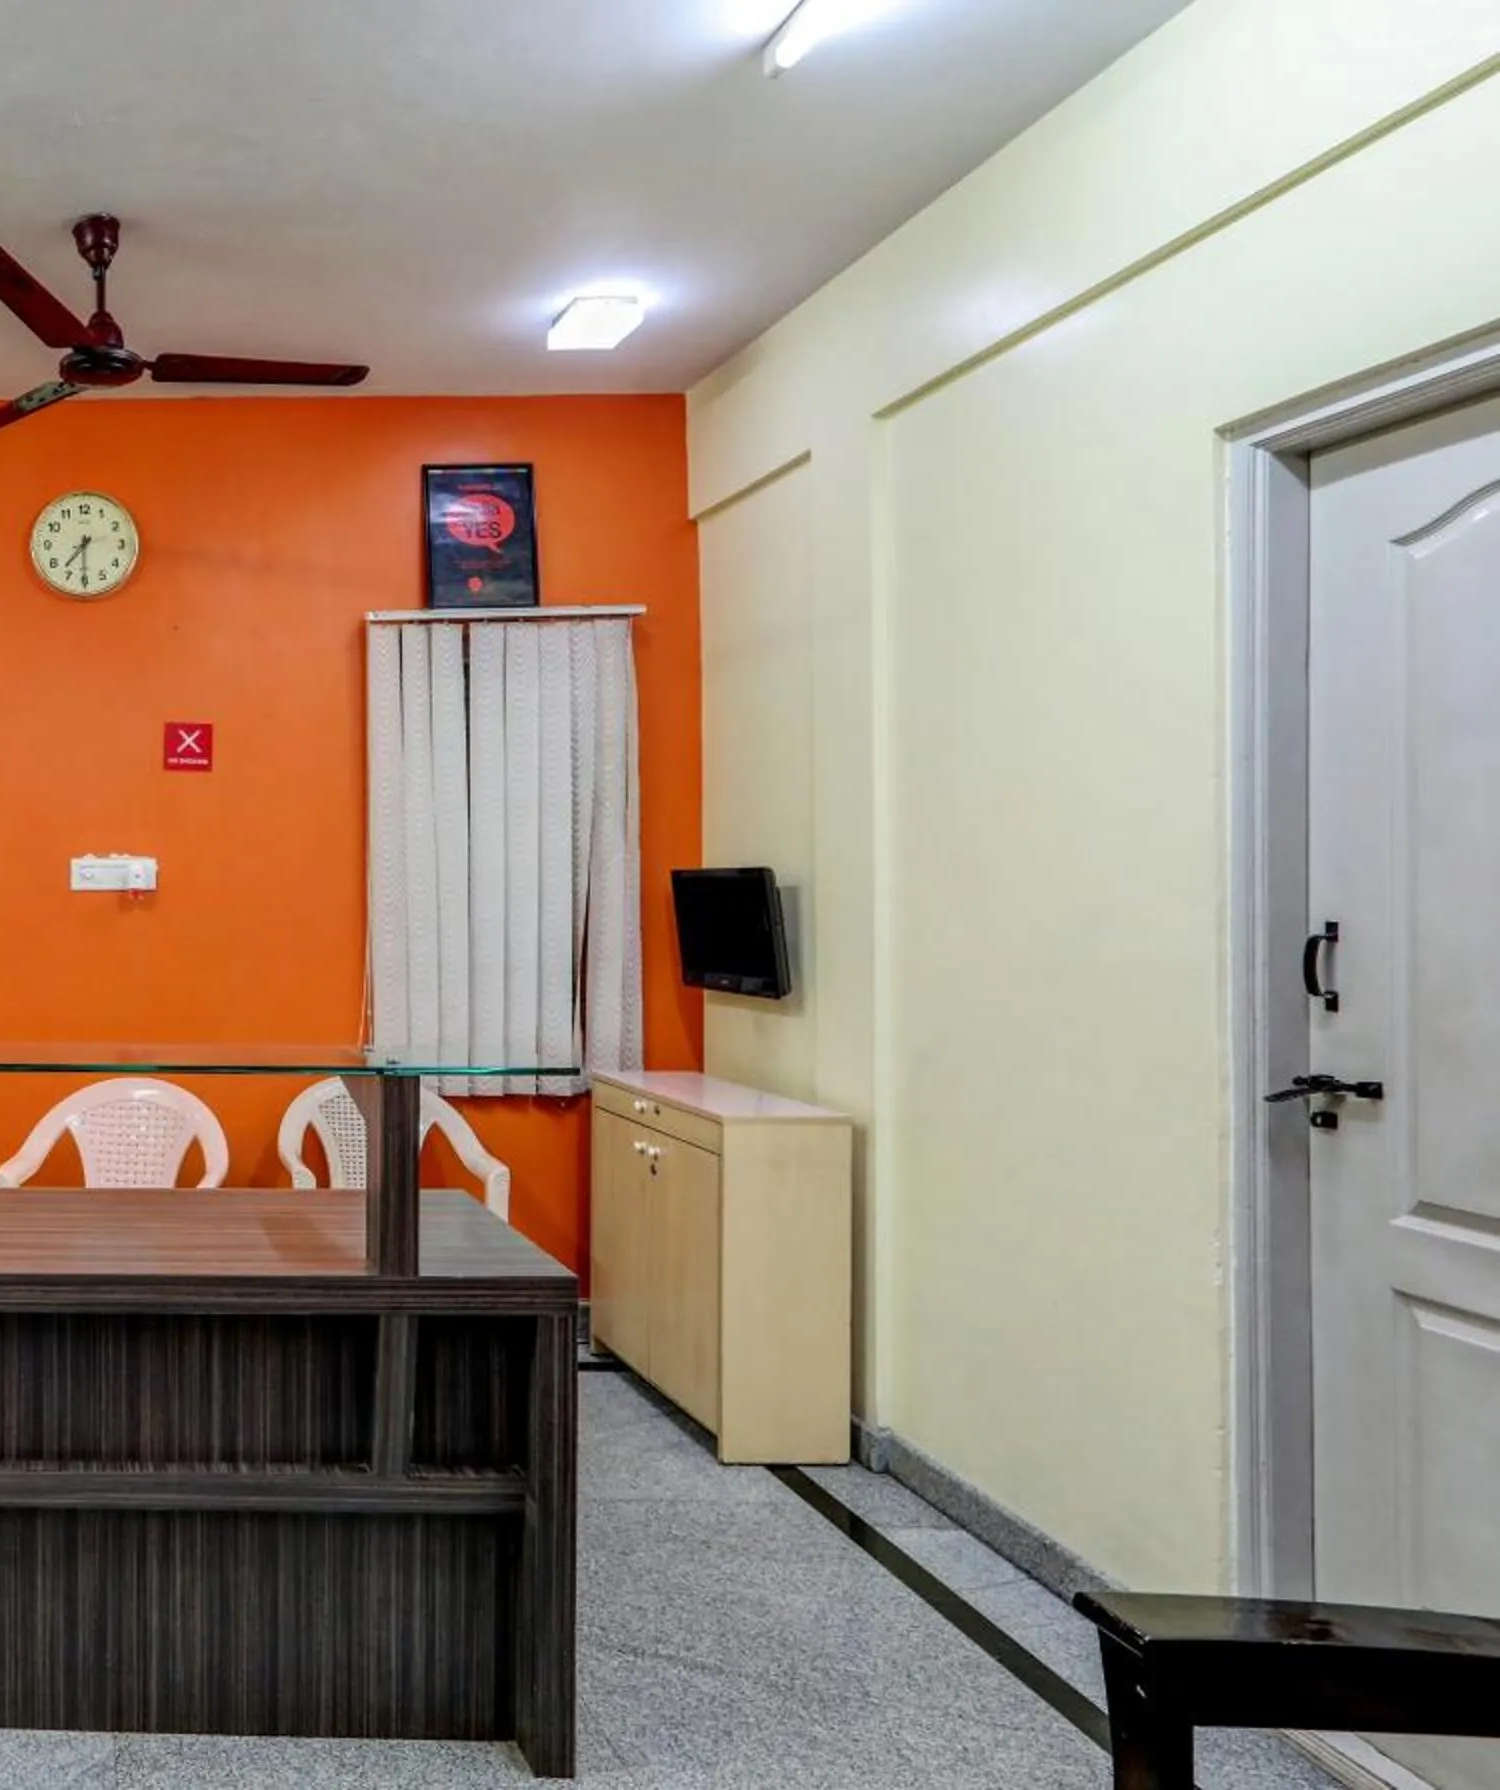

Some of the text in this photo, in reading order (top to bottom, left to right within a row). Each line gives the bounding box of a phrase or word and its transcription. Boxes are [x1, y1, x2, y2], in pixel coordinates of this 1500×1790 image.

[61, 509, 71, 519] 11
[78, 504, 91, 515] 12
[99, 508, 105, 519] 1
[48, 521, 61, 533] 10
[111, 521, 119, 532] 2
[463, 521, 501, 539] YES
[43, 539, 52, 551] 9
[117, 539, 125, 550] 3
[49, 558, 59, 569] 8
[112, 558, 119, 568] 4
[64, 570, 73, 581] 7
[99, 570, 107, 581] 5
